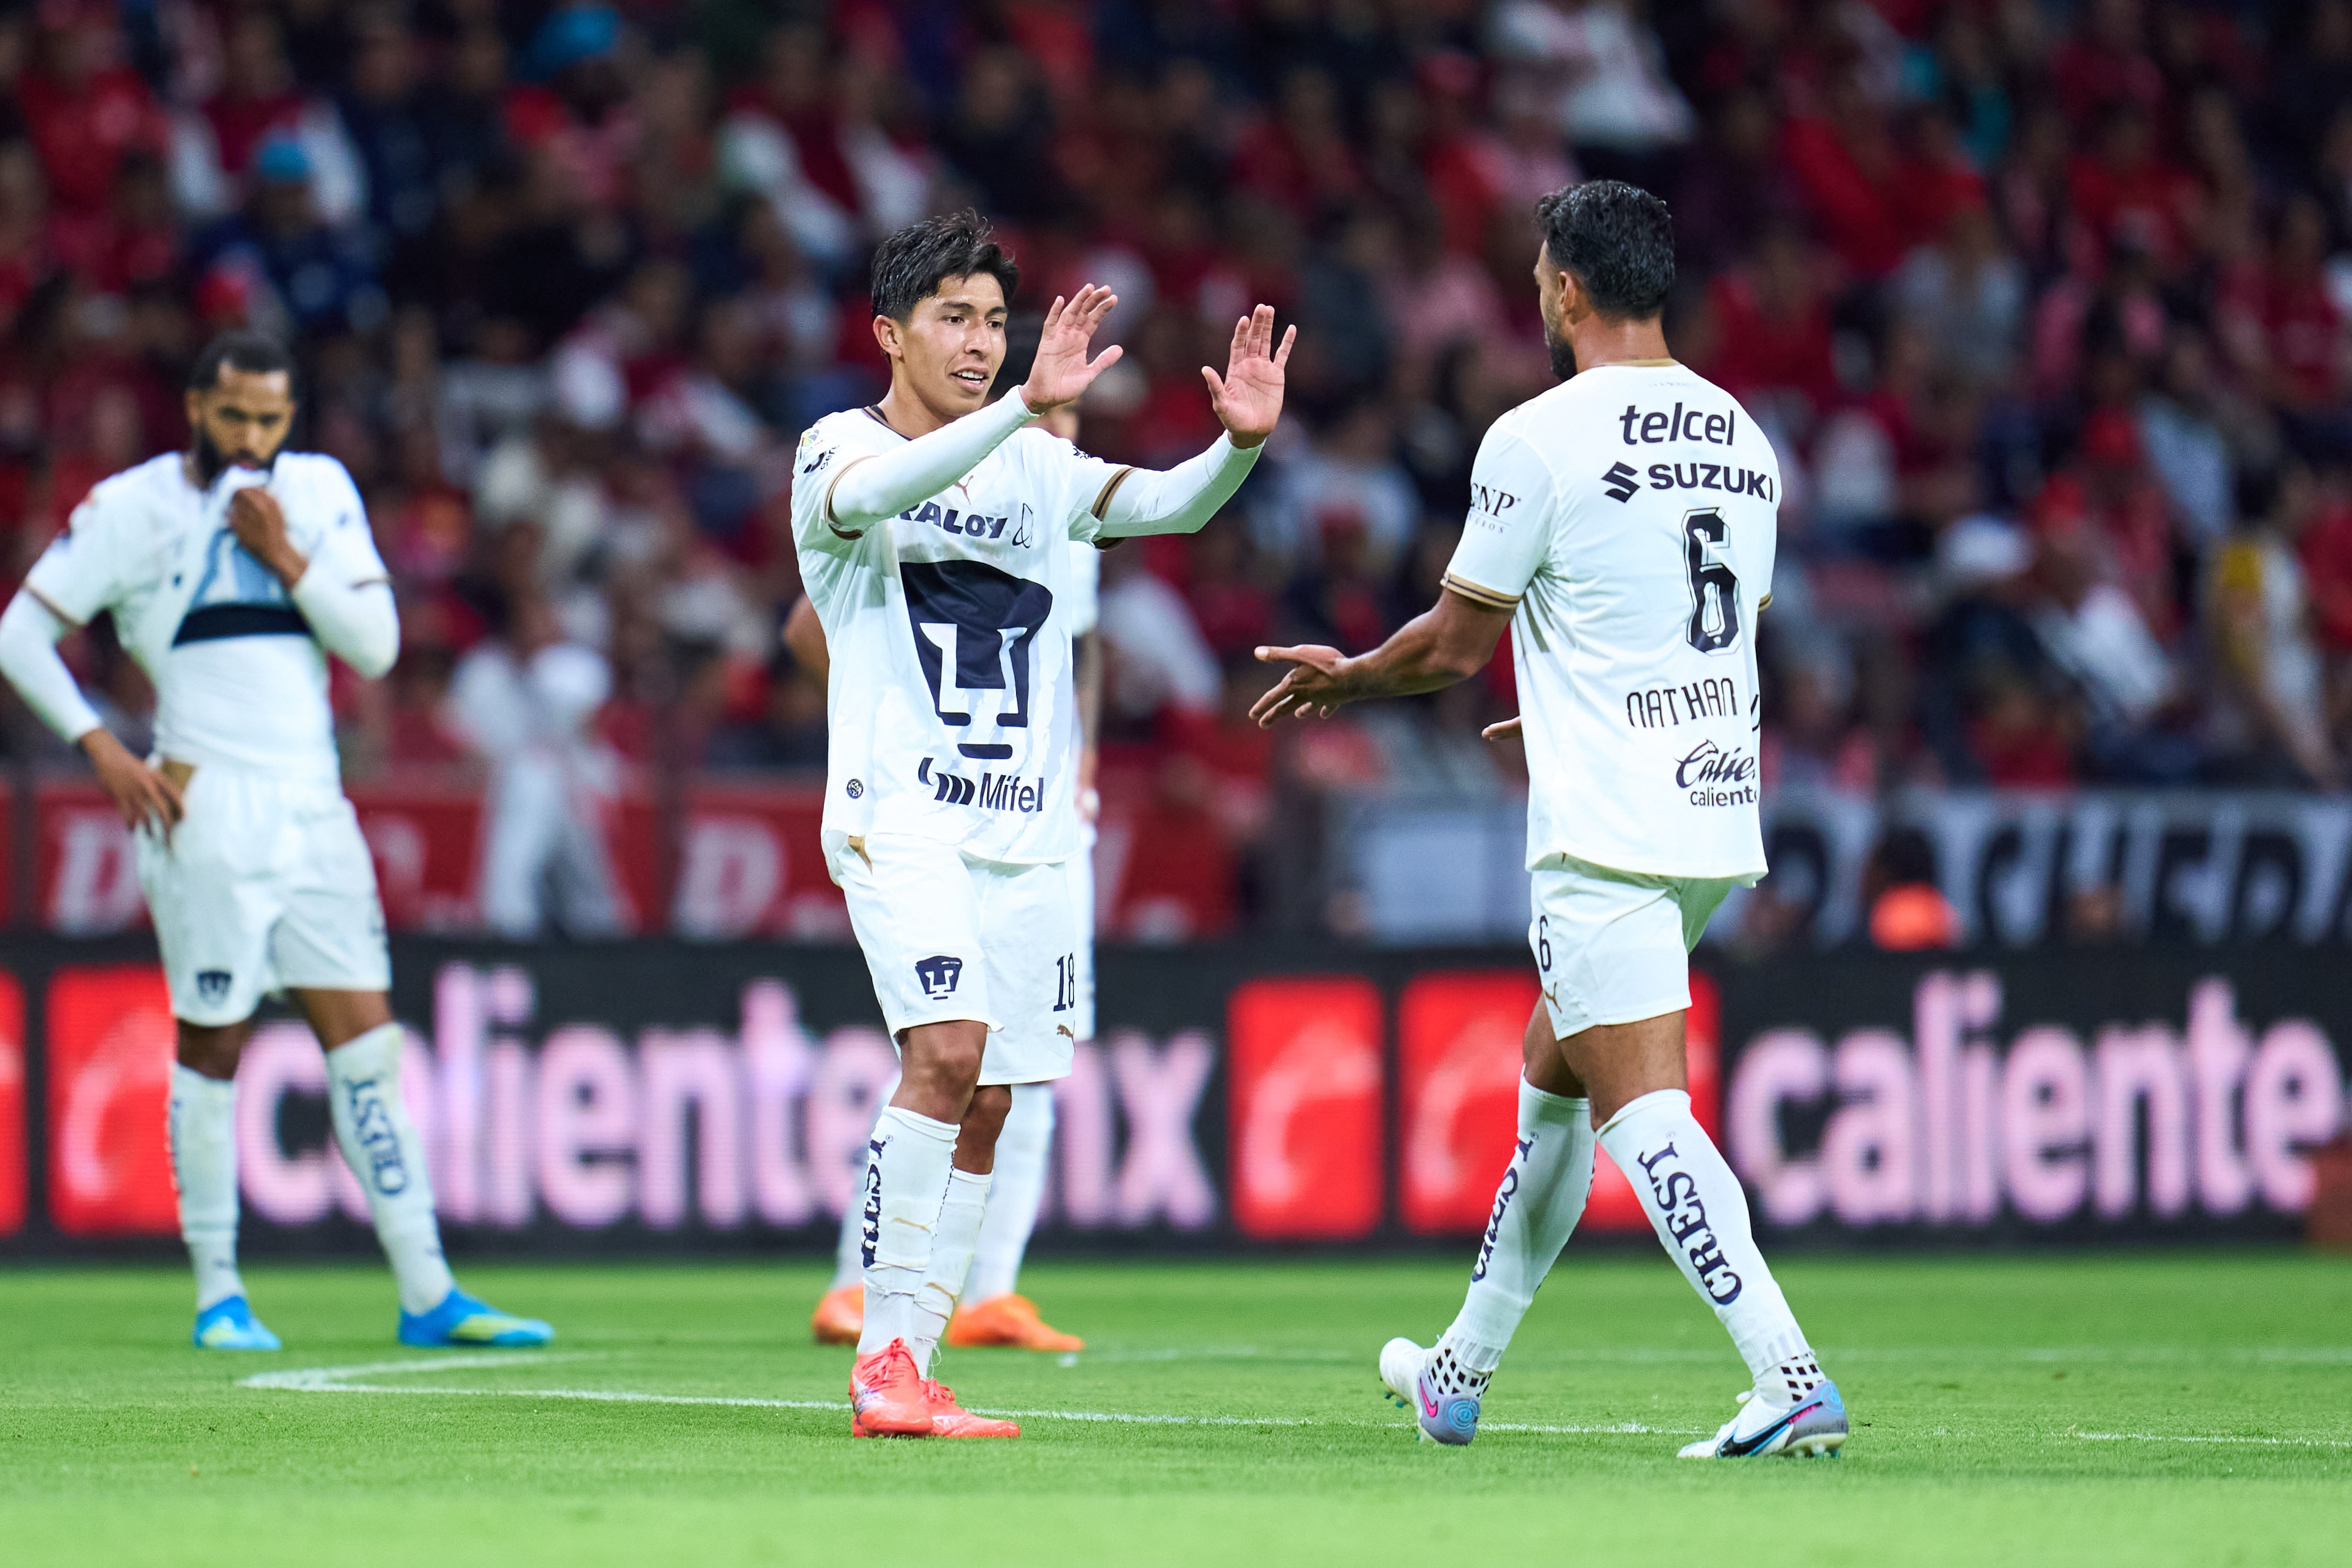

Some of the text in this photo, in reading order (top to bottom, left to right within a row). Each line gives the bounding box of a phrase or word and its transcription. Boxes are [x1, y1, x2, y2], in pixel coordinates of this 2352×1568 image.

[1619, 402, 1735, 446] telcel
[1648, 462, 1773, 503] SUZUKI
[1681, 506, 1742, 657] 6
[1626, 677, 1738, 728] NATHAN
[1673, 738, 1756, 789] Calie
[978, 772, 1044, 813] Mifel
[1690, 785, 1758, 807] calient
[1539, 915, 1552, 972] 6
[1053, 952, 1075, 1012] 18
[1728, 969, 2343, 1225] caliente
[1636, 1141, 1743, 1306] CREST
